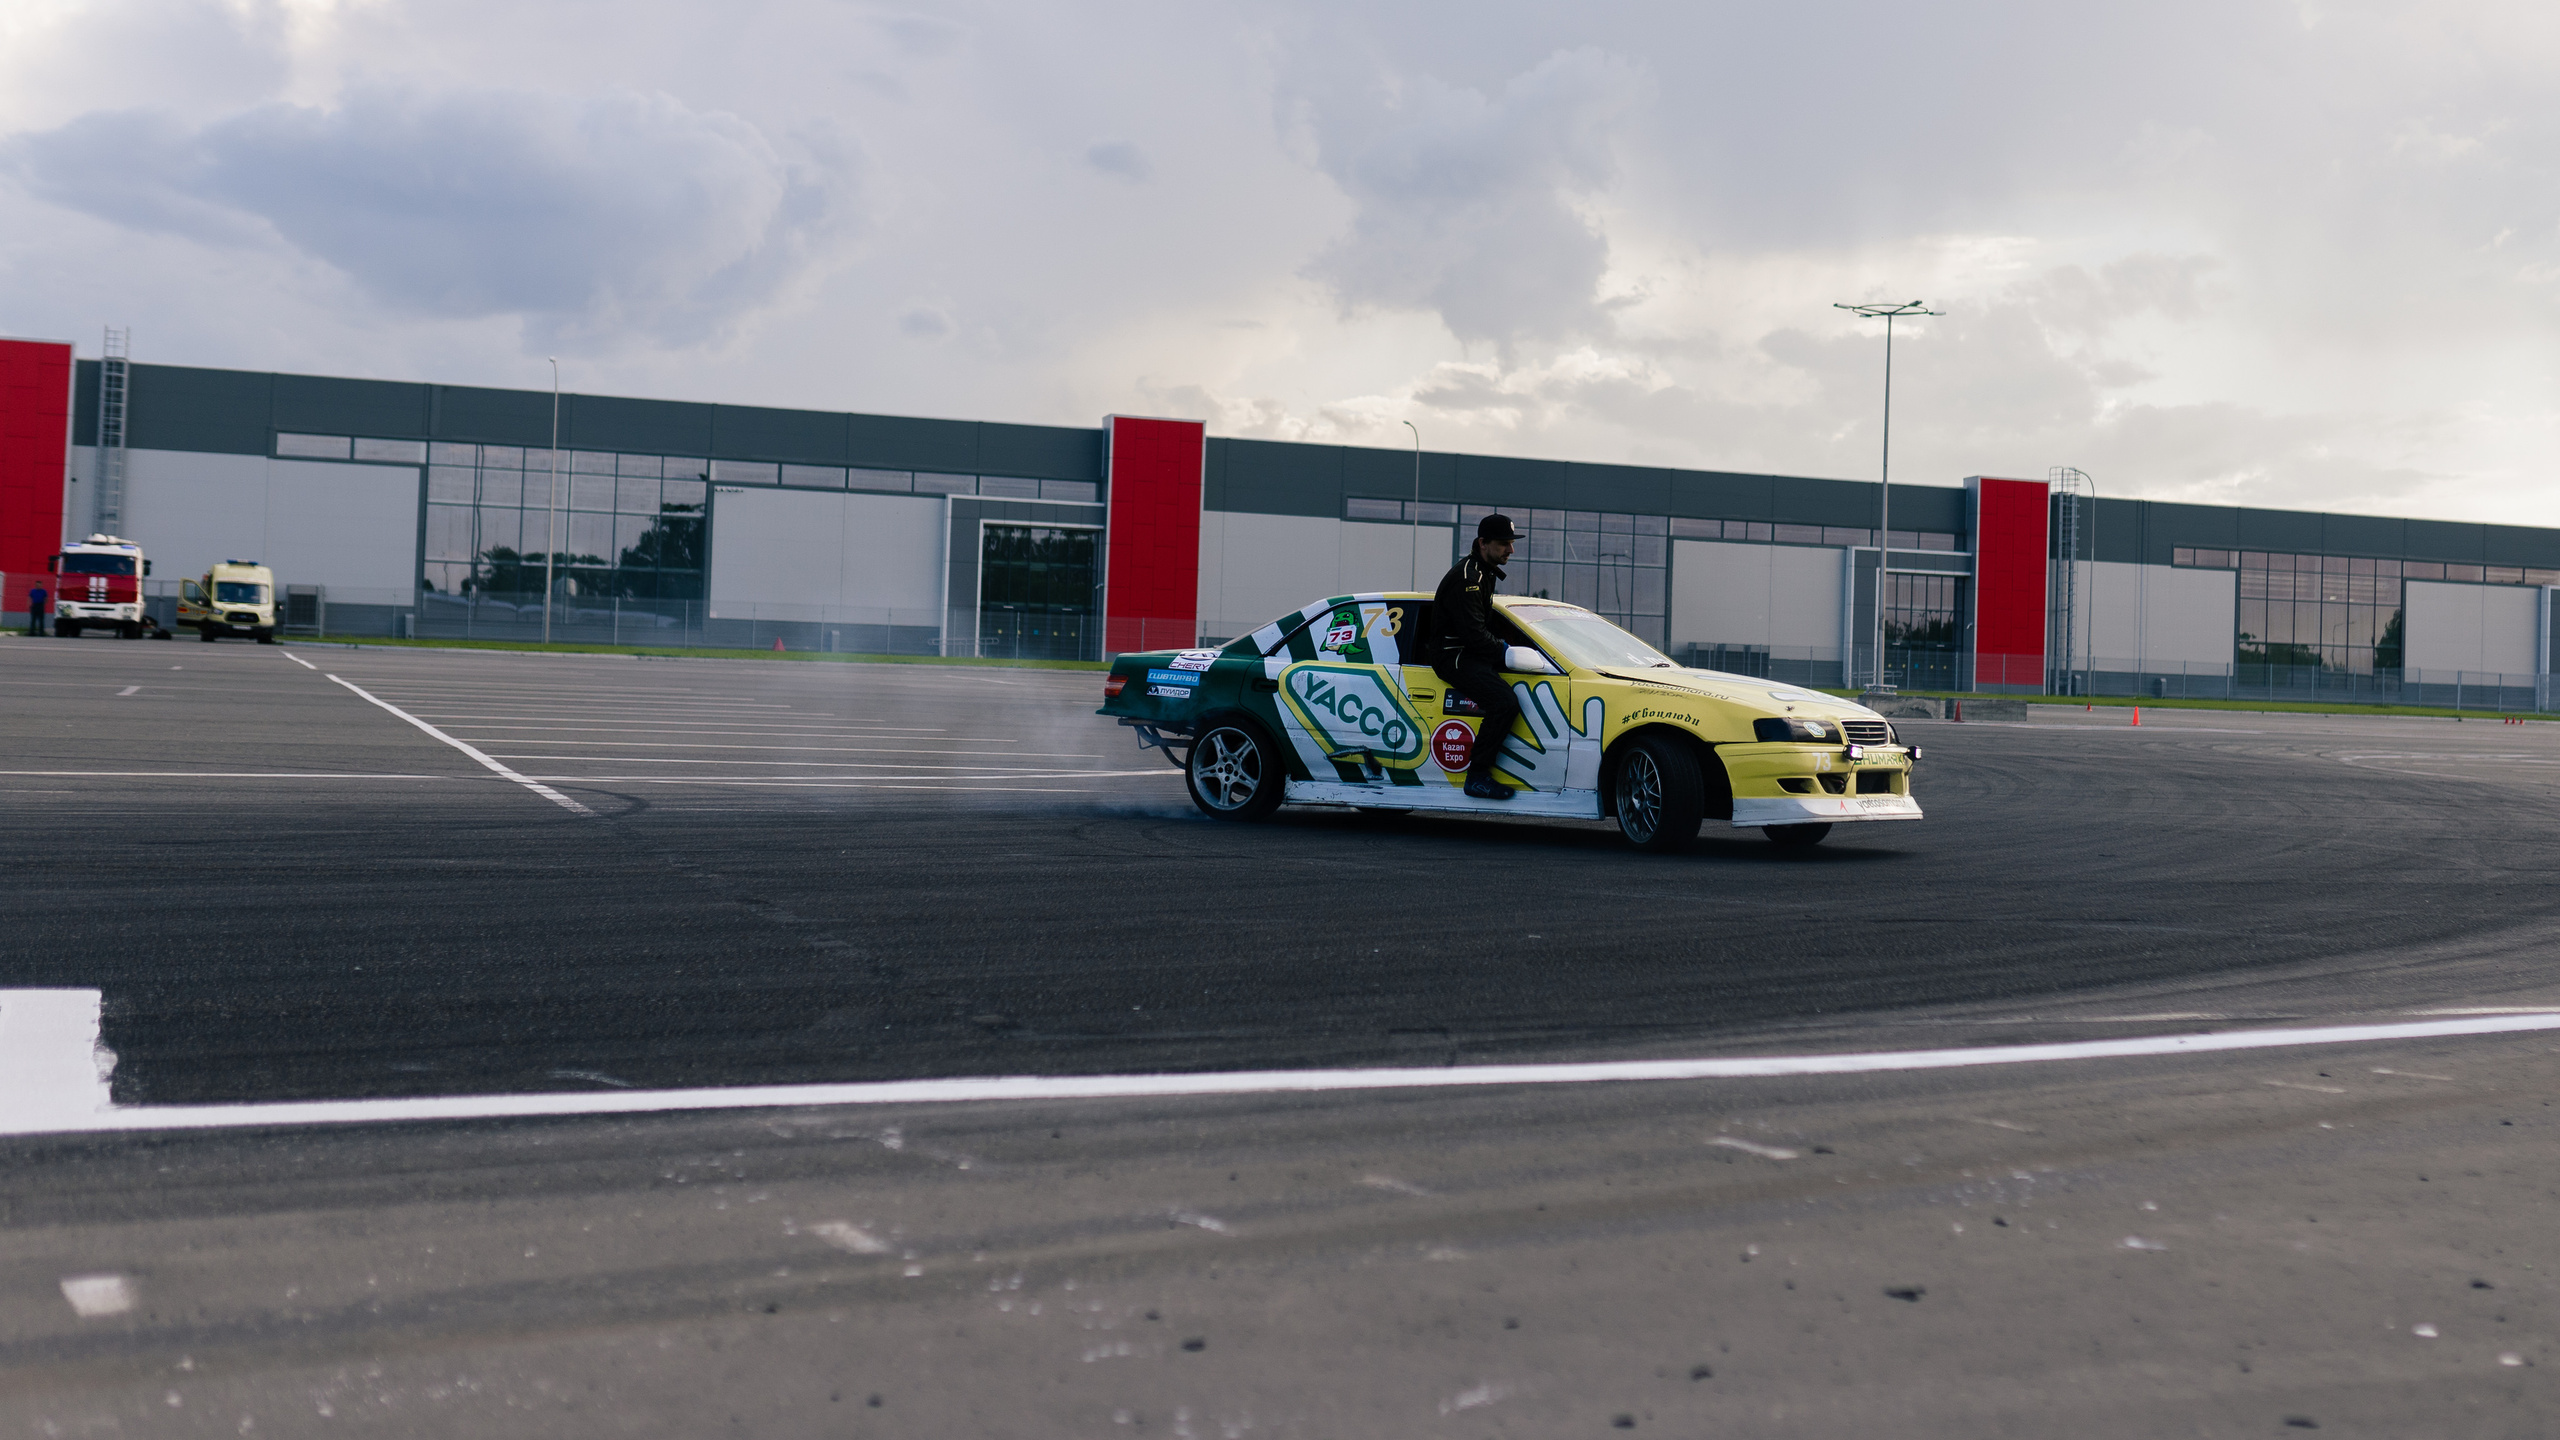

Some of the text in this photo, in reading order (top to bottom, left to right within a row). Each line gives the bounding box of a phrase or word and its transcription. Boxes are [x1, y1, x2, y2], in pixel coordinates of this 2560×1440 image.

[1360, 607, 1404, 638] 73
[1329, 630, 1353, 643] 73
[1169, 661, 1210, 670] CHERY
[1148, 672, 1199, 683] CLUBTURBO
[1630, 680, 1730, 701] yaccosamara.ru
[1303, 671, 1408, 750] YACCO
[1442, 742, 1466, 752] Kazan
[1444, 752, 1464, 764] Expo
[1811, 752, 1832, 771] 73
